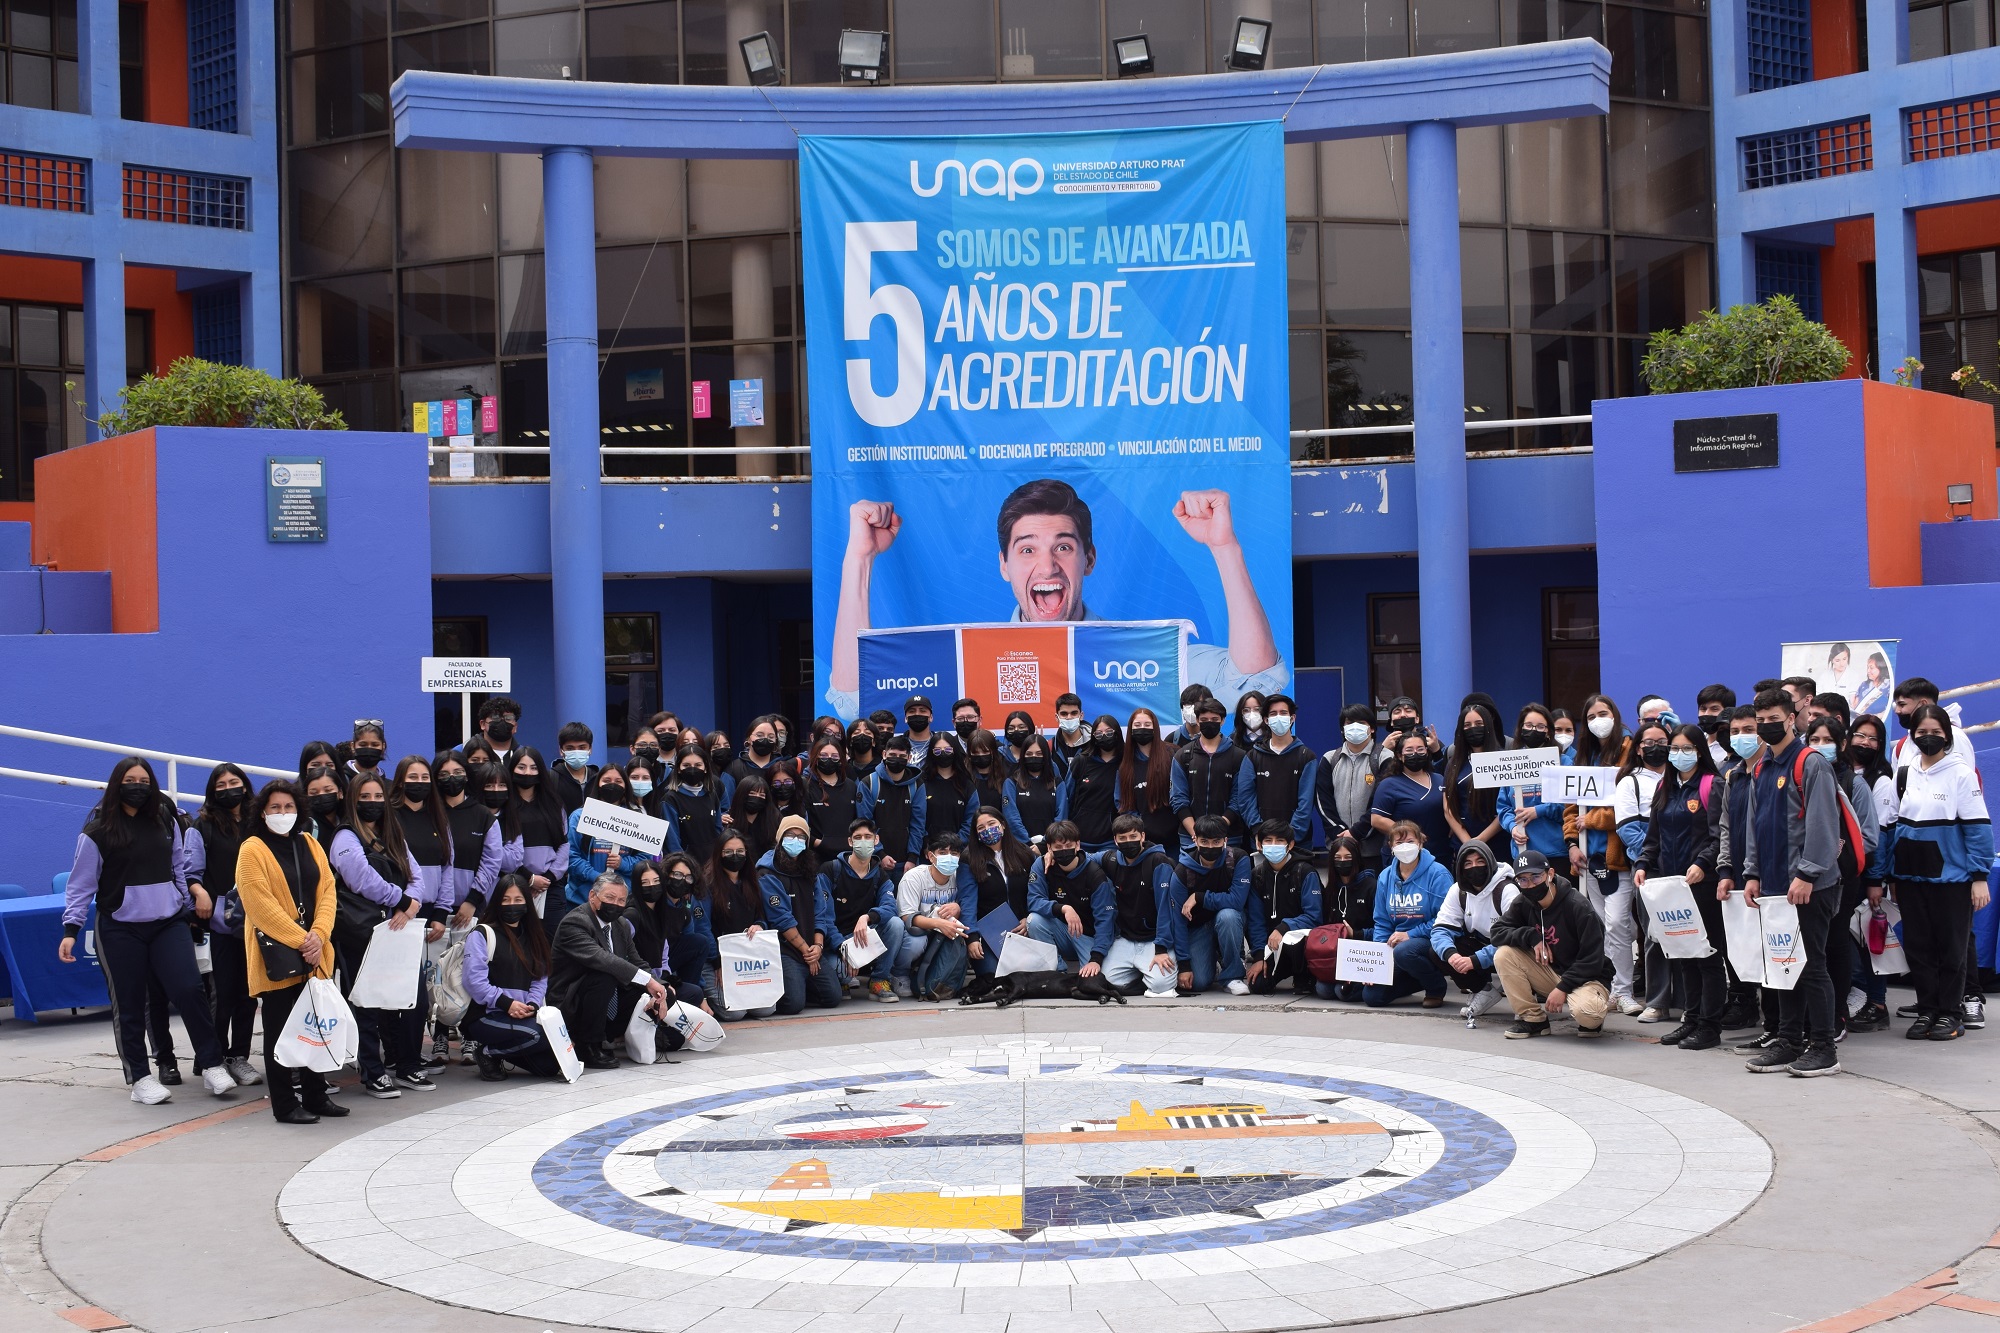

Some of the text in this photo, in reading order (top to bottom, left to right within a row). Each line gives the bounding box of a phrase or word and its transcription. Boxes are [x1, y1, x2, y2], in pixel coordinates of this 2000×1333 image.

[1053, 159, 1185, 170] UNIVERSIDAD ARTURO PRAT
[1070, 172, 1102, 180] ESTADO
[1116, 170, 1138, 179] CHILE
[1118, 182, 1156, 190] TERRITORIO
[936, 220, 1251, 268] SOMOS DE AVANZADA
[934, 271, 1126, 342] AÑOS DE
[844, 221, 925, 427] 5
[928, 326, 1248, 410] ACREDITACIÓN
[848, 436, 1262, 462] GESTIÓN INSTITUCIONAL DOCENCIA DE PREGRADO VINCULACIÓN CON EL MEDIO
[1690, 442, 1762, 452] Información Regional
[876, 673, 938, 691] unap.cl
[1475, 763, 1512, 774] CIENCIAS
[1500, 770, 1540, 780] POLÍTICAS
[1565, 775, 1598, 797] FIA
[610, 816, 632, 827] FACULTAD
[583, 816, 620, 832] CIENCIAS
[621, 828, 661, 845] HUMANAS
[1389, 893, 1423, 907] UNAP
[1656, 909, 1692, 922] UNAP
[1766, 934, 1791, 946] UNAP
[734, 960, 770, 972] UNAP
[304, 1012, 338, 1031] UNAP
